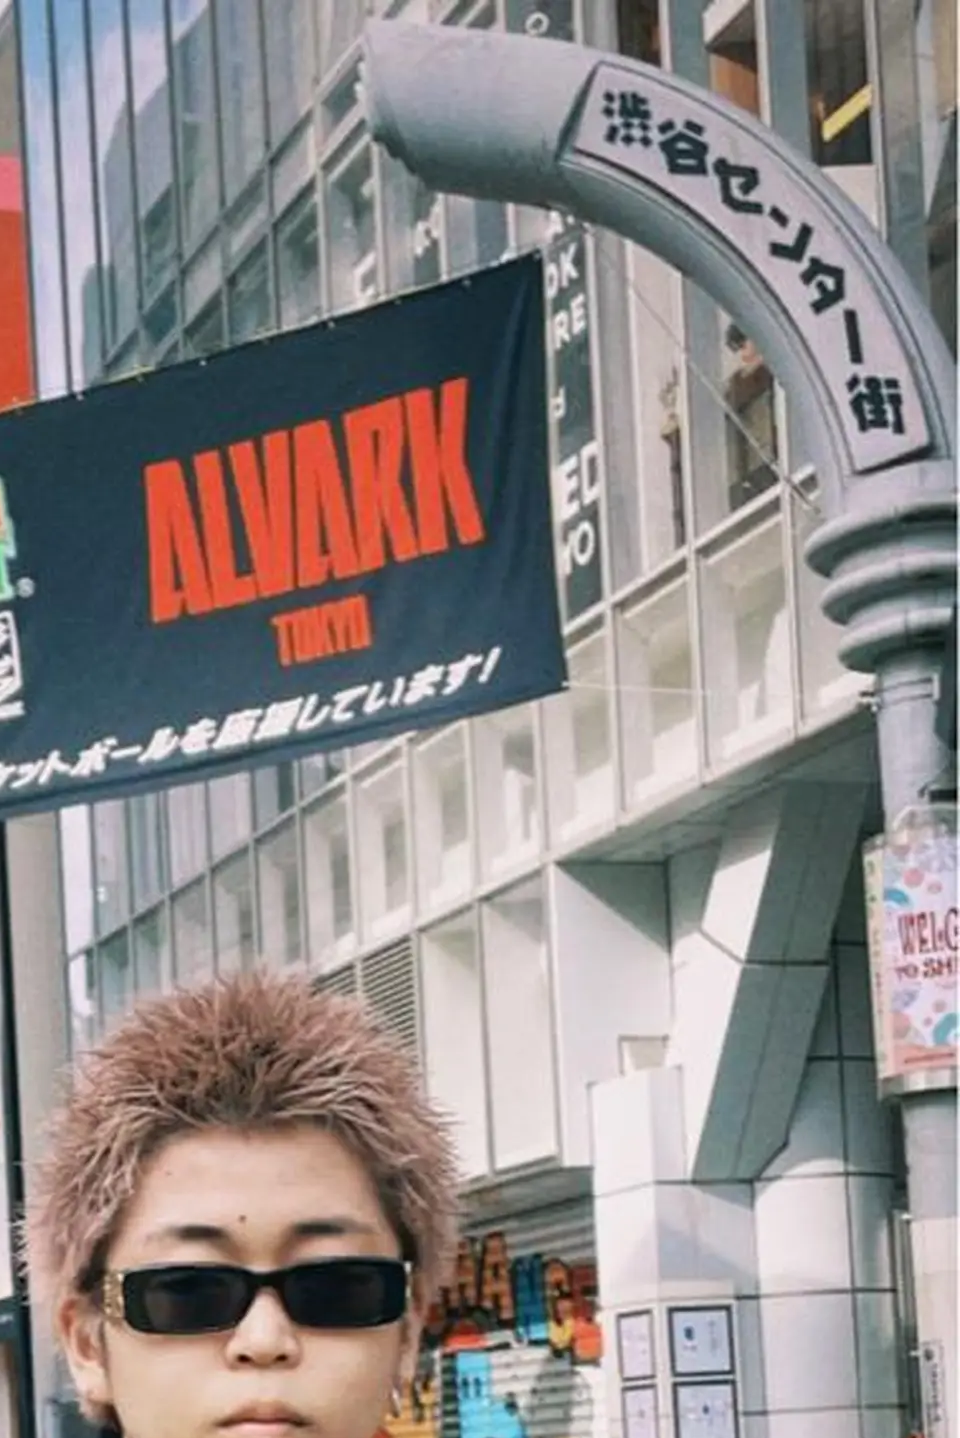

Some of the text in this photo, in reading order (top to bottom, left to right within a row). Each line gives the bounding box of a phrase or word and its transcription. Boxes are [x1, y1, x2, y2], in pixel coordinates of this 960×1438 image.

[602, 90, 907, 436] 渋谷センター街
[143, 376, 486, 625] ALVARK
